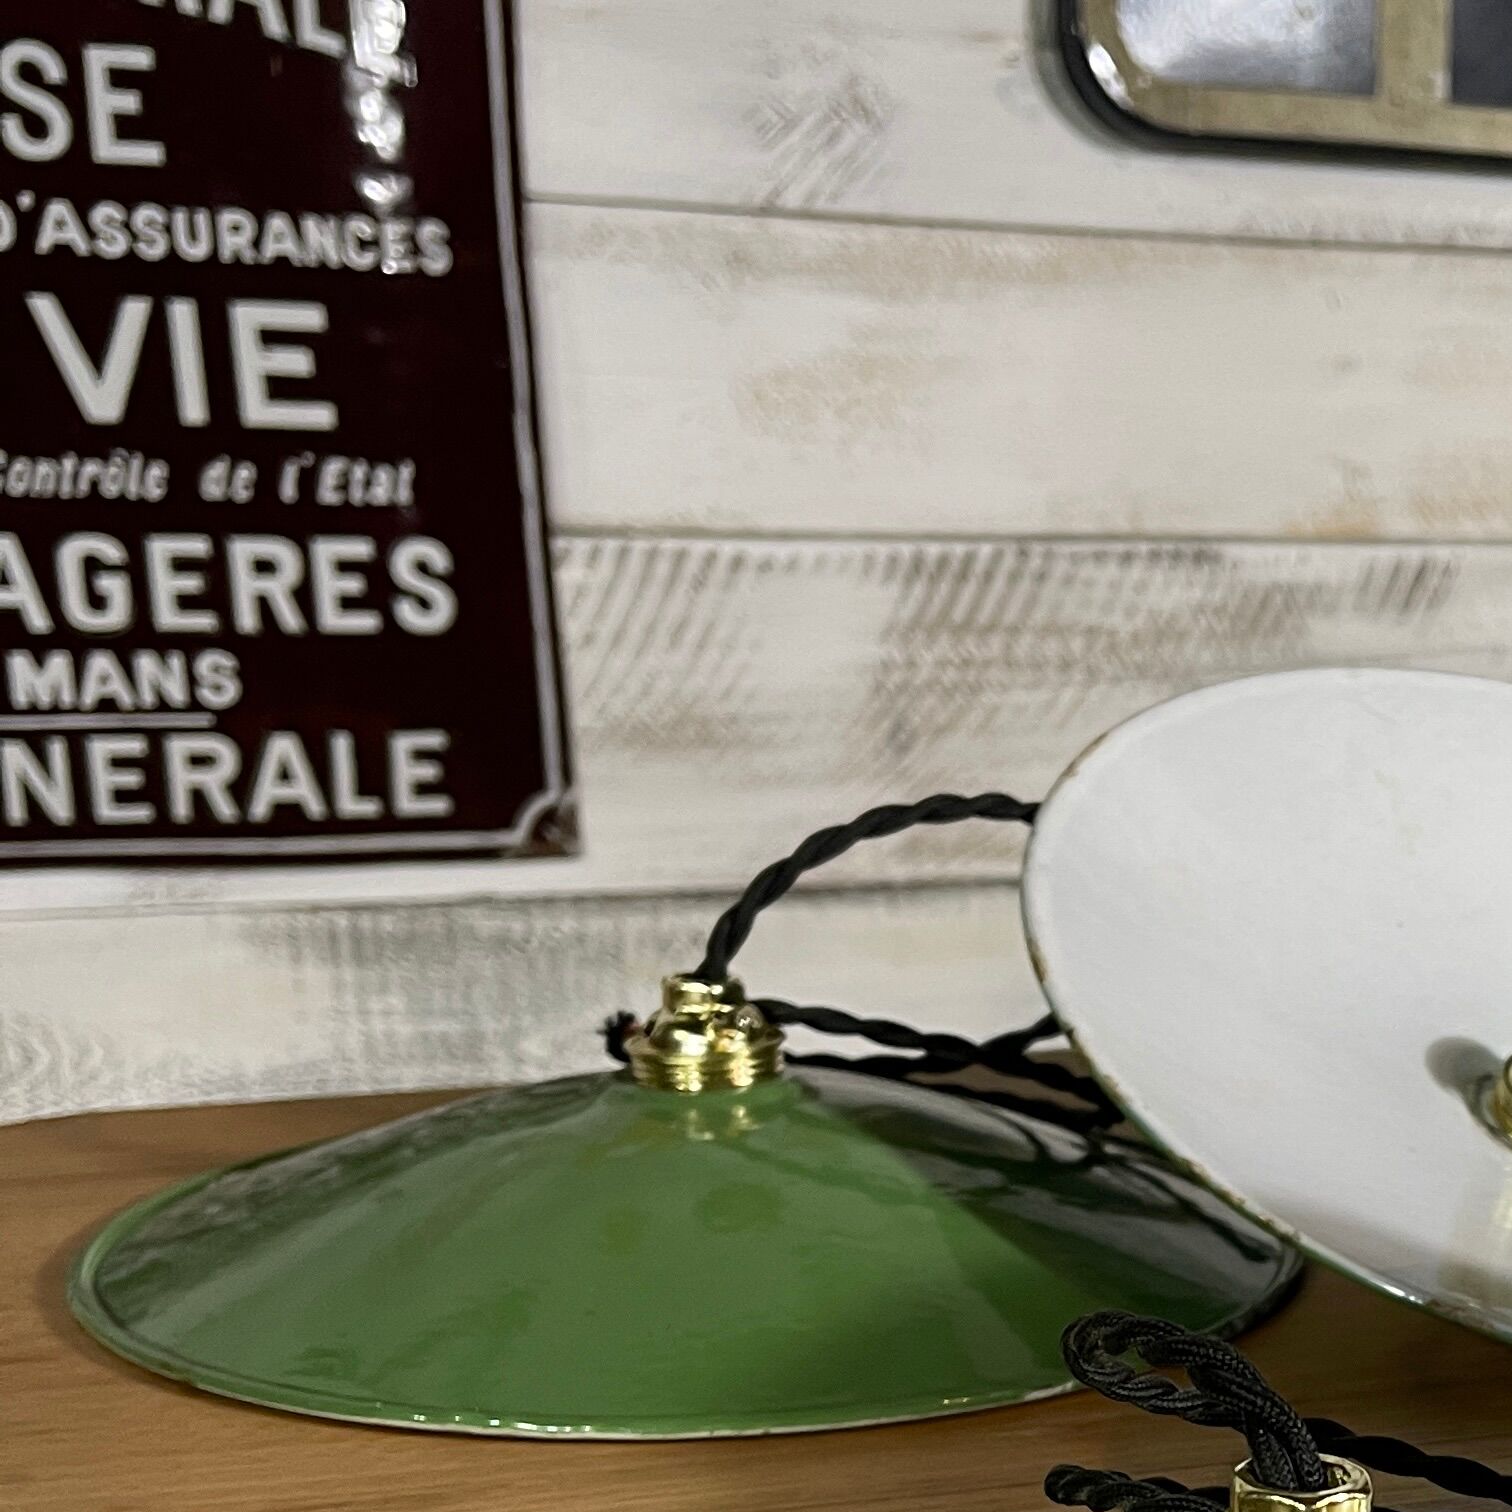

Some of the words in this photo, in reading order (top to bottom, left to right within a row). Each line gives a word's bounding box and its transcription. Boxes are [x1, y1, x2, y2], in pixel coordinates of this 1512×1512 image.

[0, 40, 166, 166] SE
[25, 292, 338, 430] VIE
[200, 454, 257, 503] de
[0, 532, 457, 635] AGERES
[7, 649, 242, 711] MANS
[0, 731, 455, 826] NERALE
